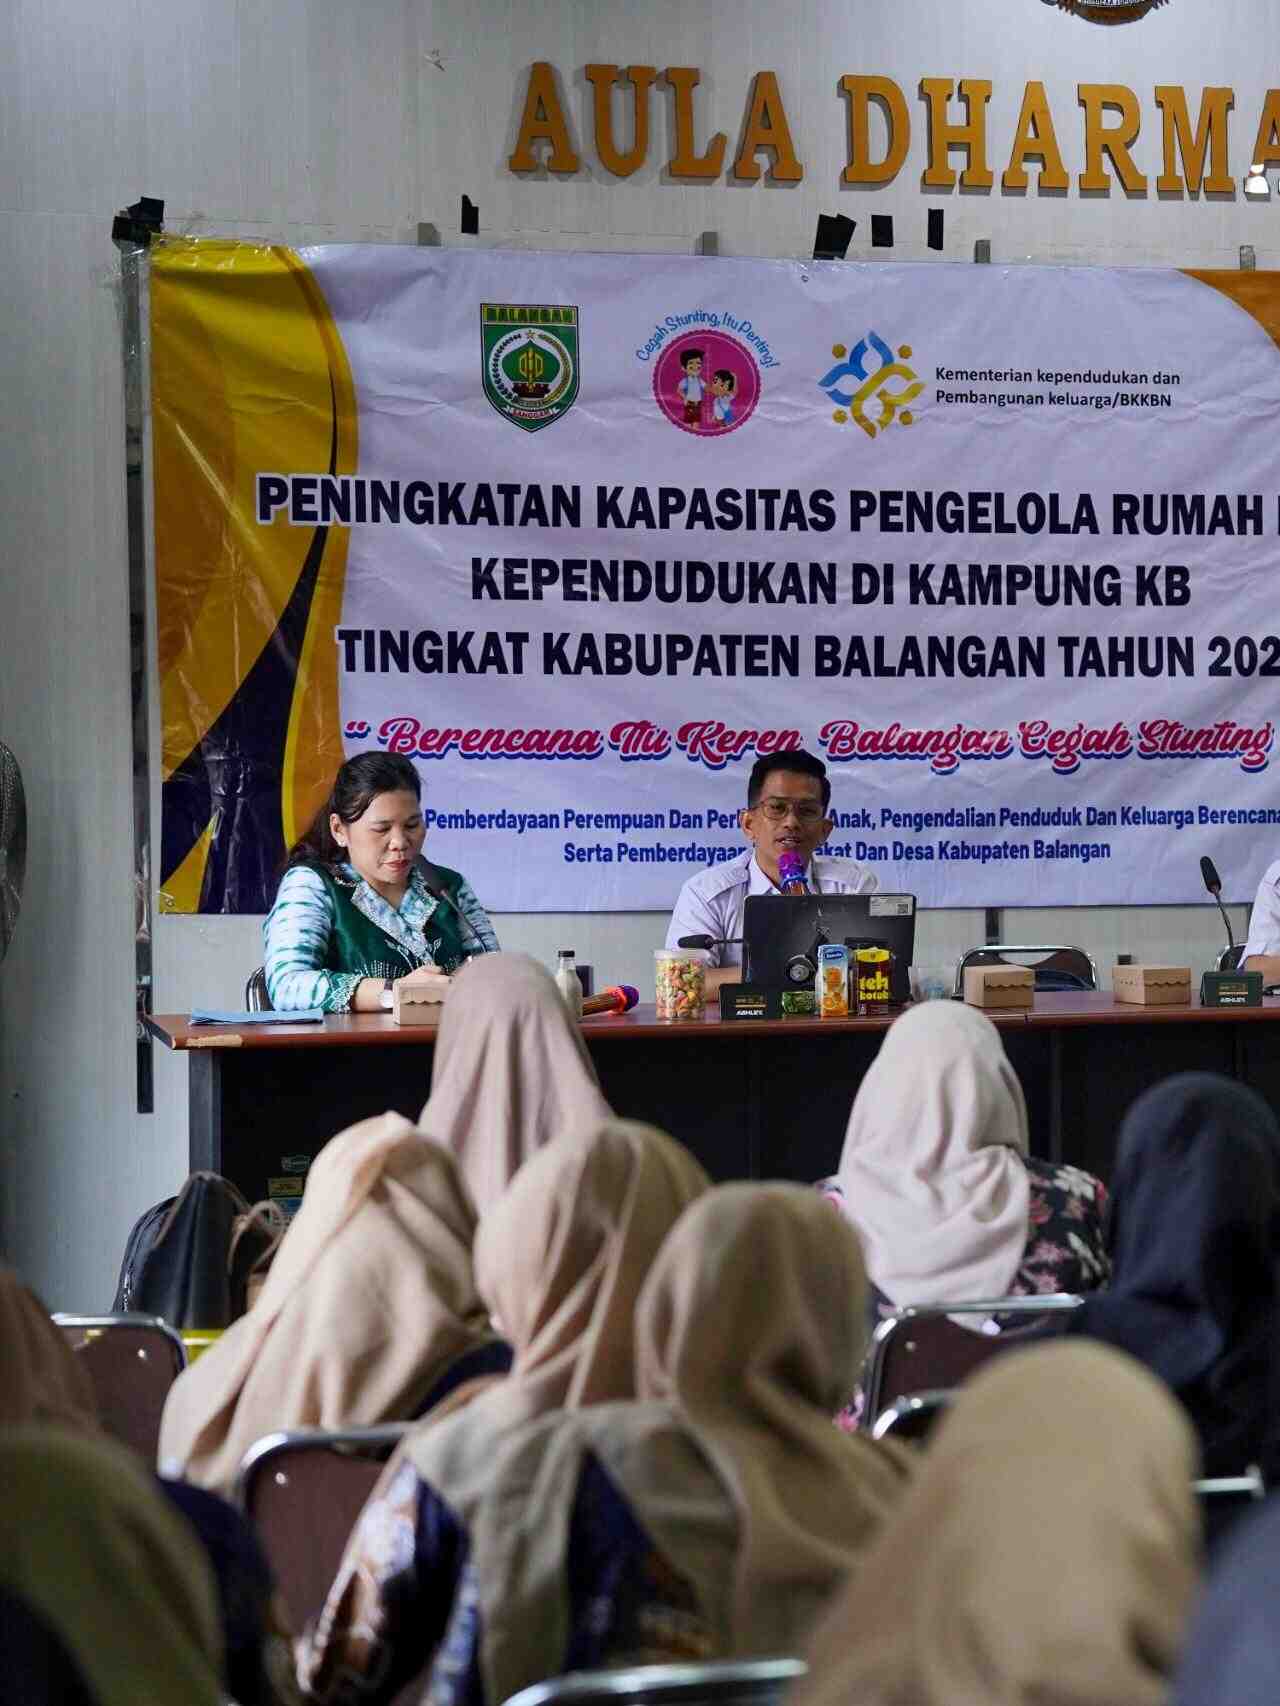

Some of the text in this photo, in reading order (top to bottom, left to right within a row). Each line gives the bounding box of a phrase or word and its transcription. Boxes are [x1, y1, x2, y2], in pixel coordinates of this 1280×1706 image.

[508, 61, 803, 180] AULA
[636, 325, 669, 361] Cegah
[722, 312, 740, 329] Itu
[935, 367, 1181, 386] Kementerian kependudukan dan
[936, 389, 1172, 409] Pembangunan keluarga/BKKBN
[258, 476, 581, 528] PENINGKATAN
[597, 485, 837, 532] KAPASITAS
[850, 489, 1100, 535] PENGELOLA
[1113, 493, 1264, 536] RUMAH
[471, 557, 1191, 607] KEPENDUDUKAN DI KAMPUNG KB
[338, 629, 529, 674] TINGKAT
[543, 632, 799, 677] KABUPATEN
[815, 635, 1046, 678] BALANGAN
[1058, 636, 1194, 678] TAHUN
[378, 717, 603, 760] Berencana
[608, 719, 671, 761] Itu
[676, 720, 802, 770] Keren
[818, 719, 1014, 775] Balangan
[1016, 719, 1131, 775] Cegah
[1138, 718, 1274, 773] Stunting
[425, 809, 560, 834] Pemberdayaan
[563, 808, 665, 834] Perempuan
[670, 809, 703, 829] Dan
[828, 808, 876, 831] Anak,
[880, 807, 996, 833] Pengendalian
[1000, 807, 1082, 827] Penduduk
[1087, 807, 1117, 826] Dan
[1121, 806, 1195, 832] Keluarga
[563, 842, 613, 863] Serta
[855, 841, 888, 861] Dan
[893, 840, 934, 861] Desa
[939, 840, 1030, 864] Kabupaten
[1034, 839, 1111, 864] Balangan
[859, 971, 889, 990] teh
